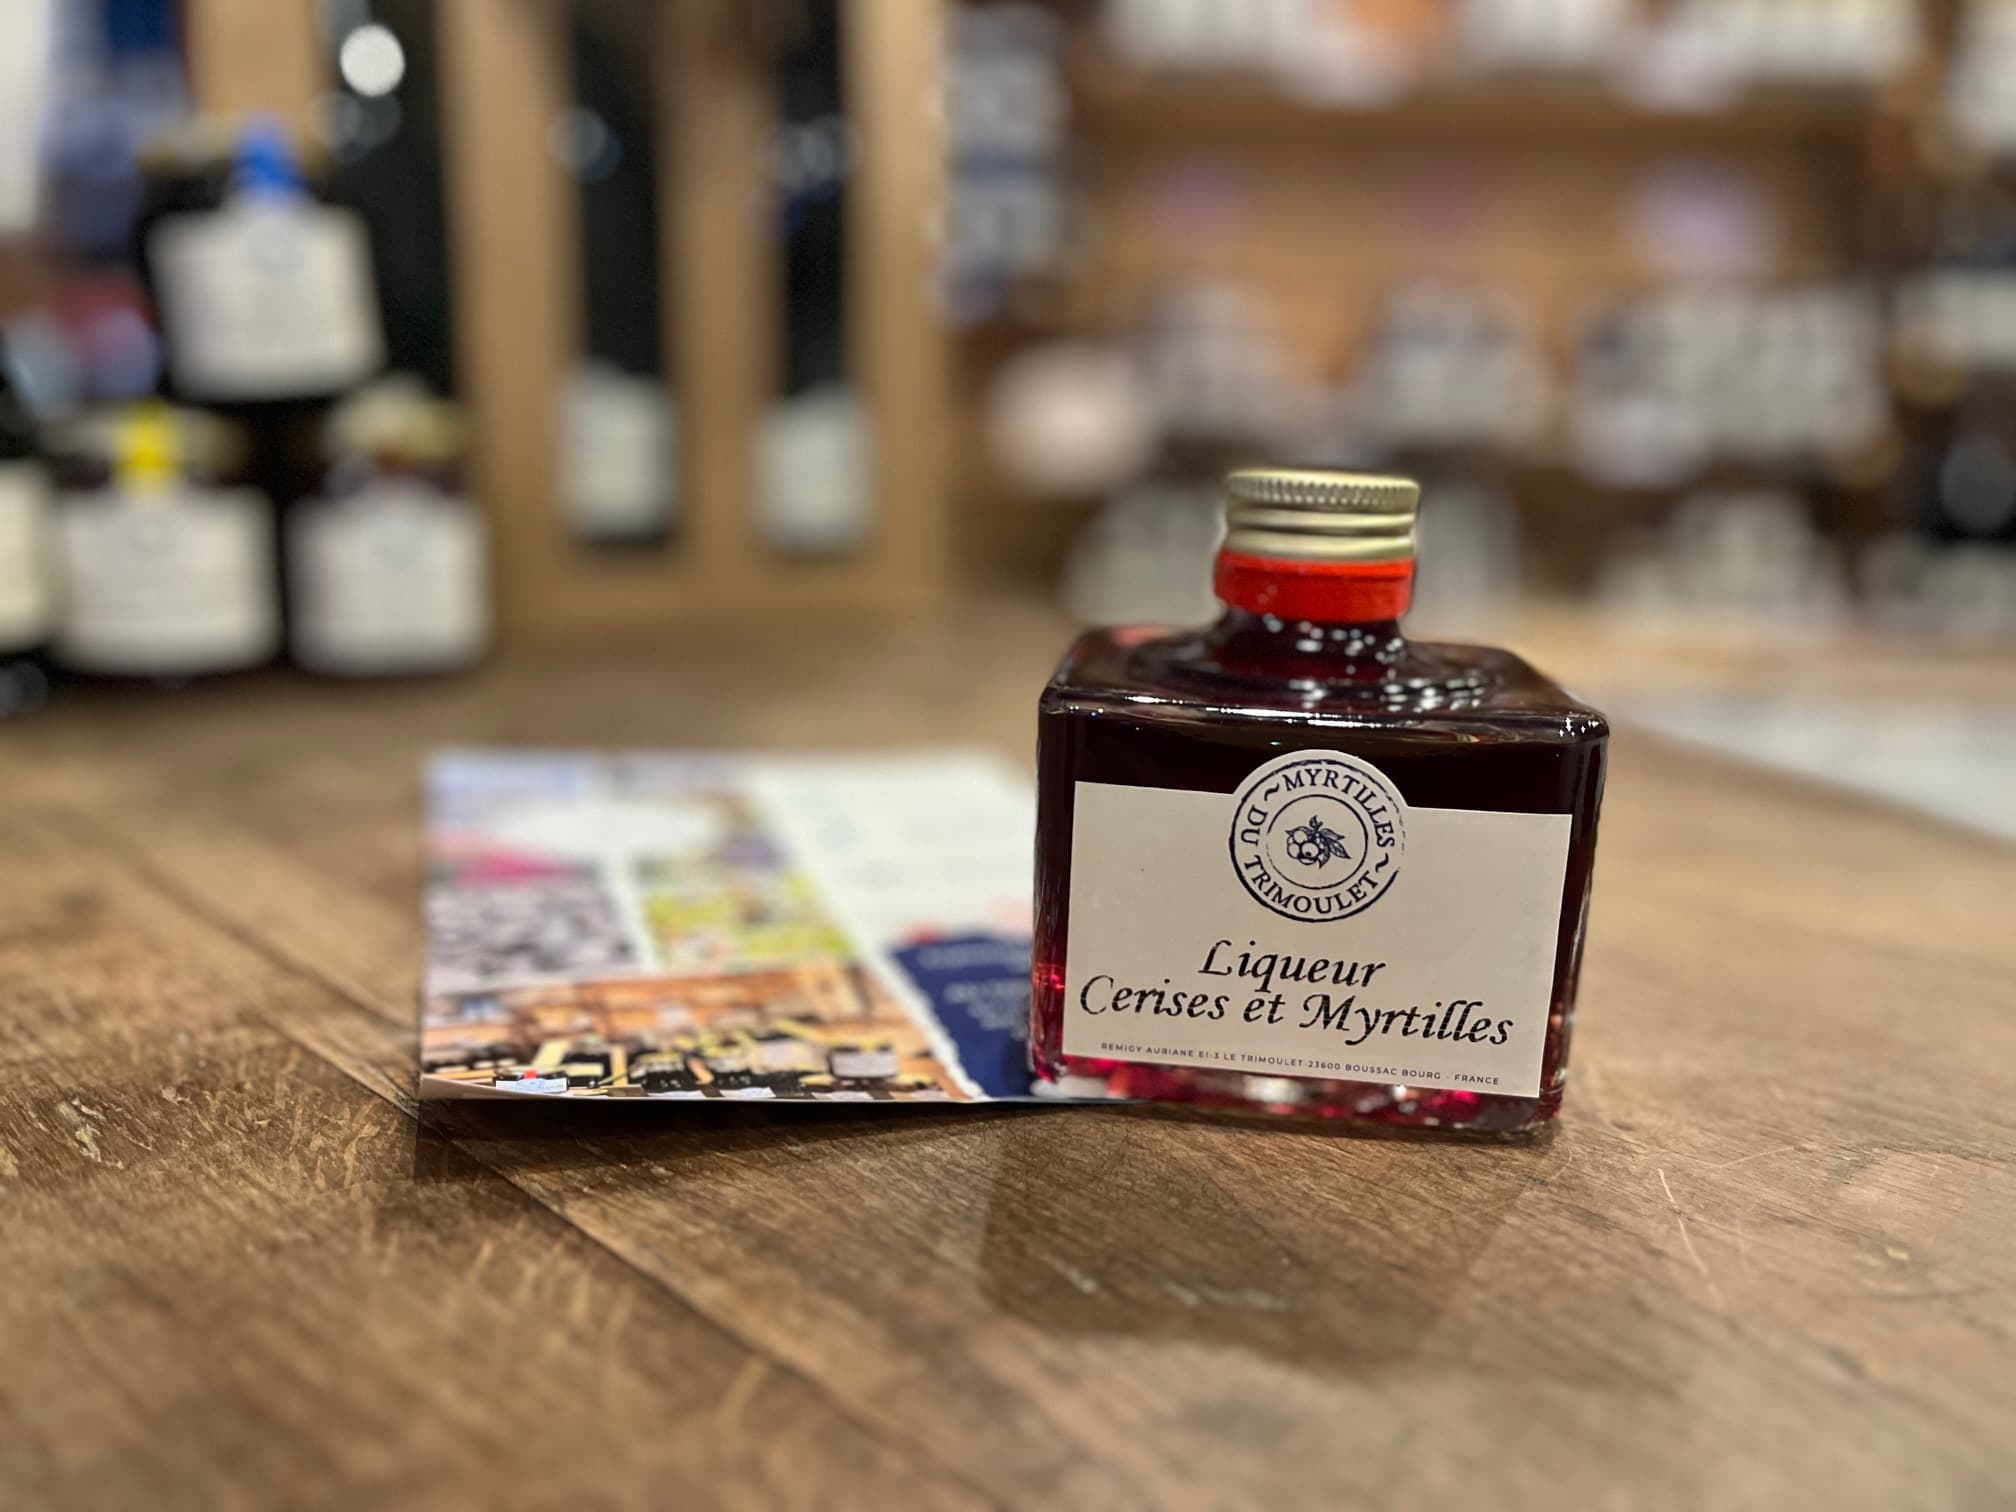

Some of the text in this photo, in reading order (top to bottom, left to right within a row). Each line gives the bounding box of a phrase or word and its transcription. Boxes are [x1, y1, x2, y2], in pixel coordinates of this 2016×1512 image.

[1282, 768, 1395, 848] MYRTILLES
[1240, 804, 1378, 914] DU TRIMOULET
[1198, 939, 1387, 993] Liqueur
[1080, 975, 1231, 1021] Cerises
[1243, 993, 1286, 1025] et
[1298, 993, 1514, 1046] Myrtilles
[1101, 1042, 1142, 1053] REMIGY
[1145, 1047, 1194, 1057] AURIANE
[1223, 1052, 1236, 1061] LE
[1345, 1063, 1398, 1075] BOUSSAC
[1401, 1068, 1441, 1080] BOURG
[1454, 1073, 1500, 1085] FRANCE
